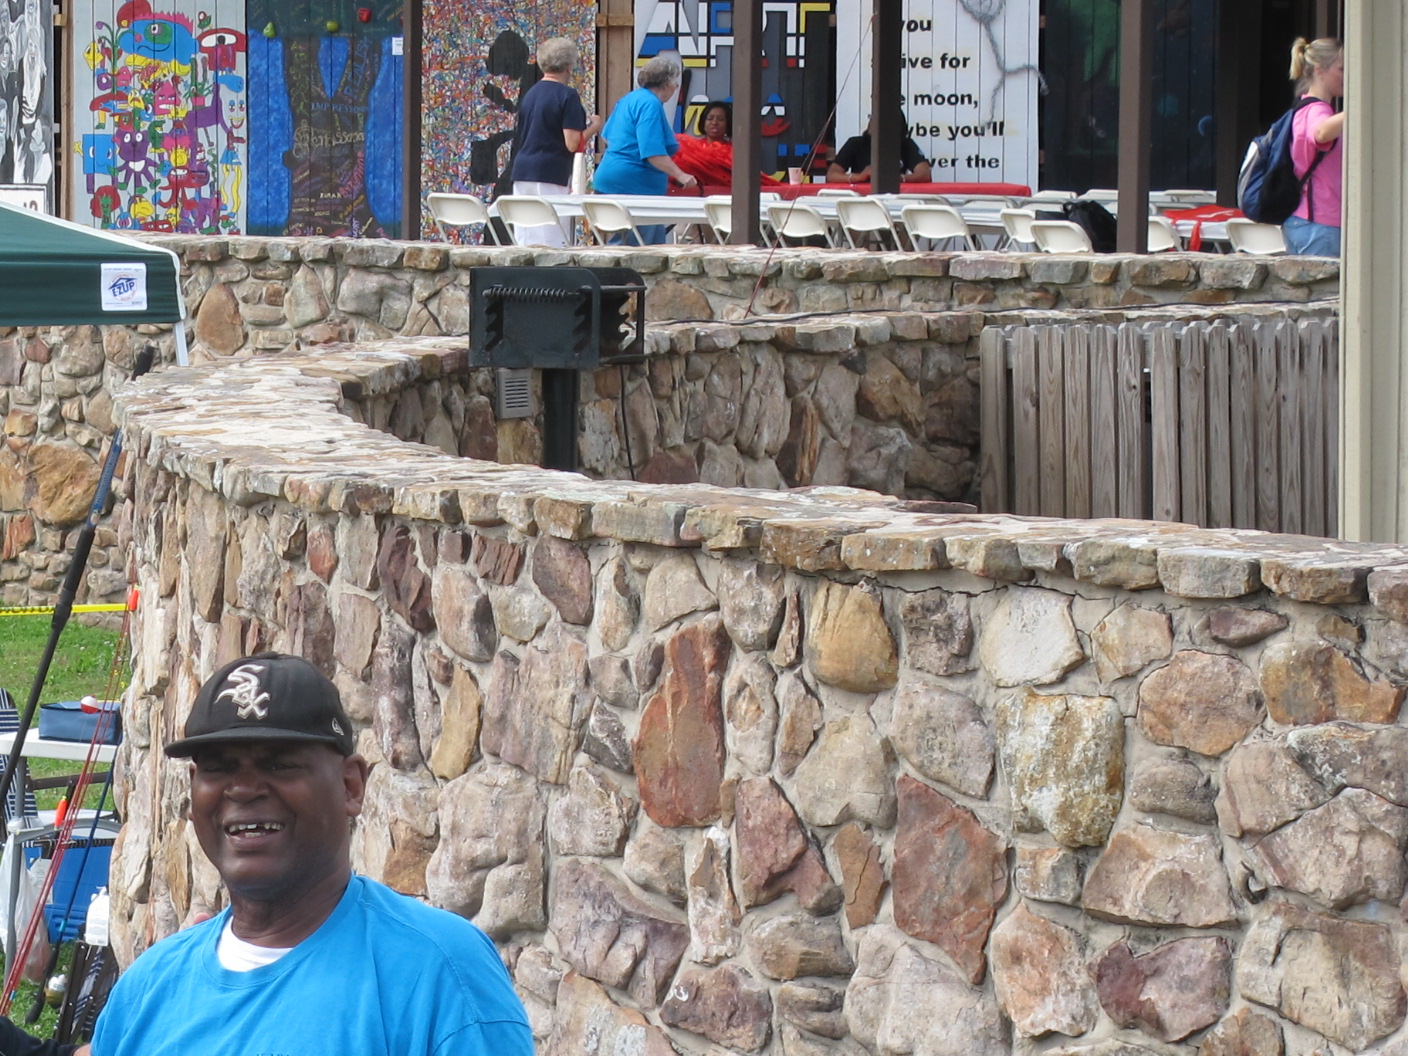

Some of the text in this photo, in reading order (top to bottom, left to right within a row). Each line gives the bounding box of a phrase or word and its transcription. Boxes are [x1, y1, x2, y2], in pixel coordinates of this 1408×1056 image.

[940, 53, 971, 69] for
[914, 93, 978, 108] moon,
[947, 121, 1004, 141] you'll
[925, 154, 999, 168] ver the
